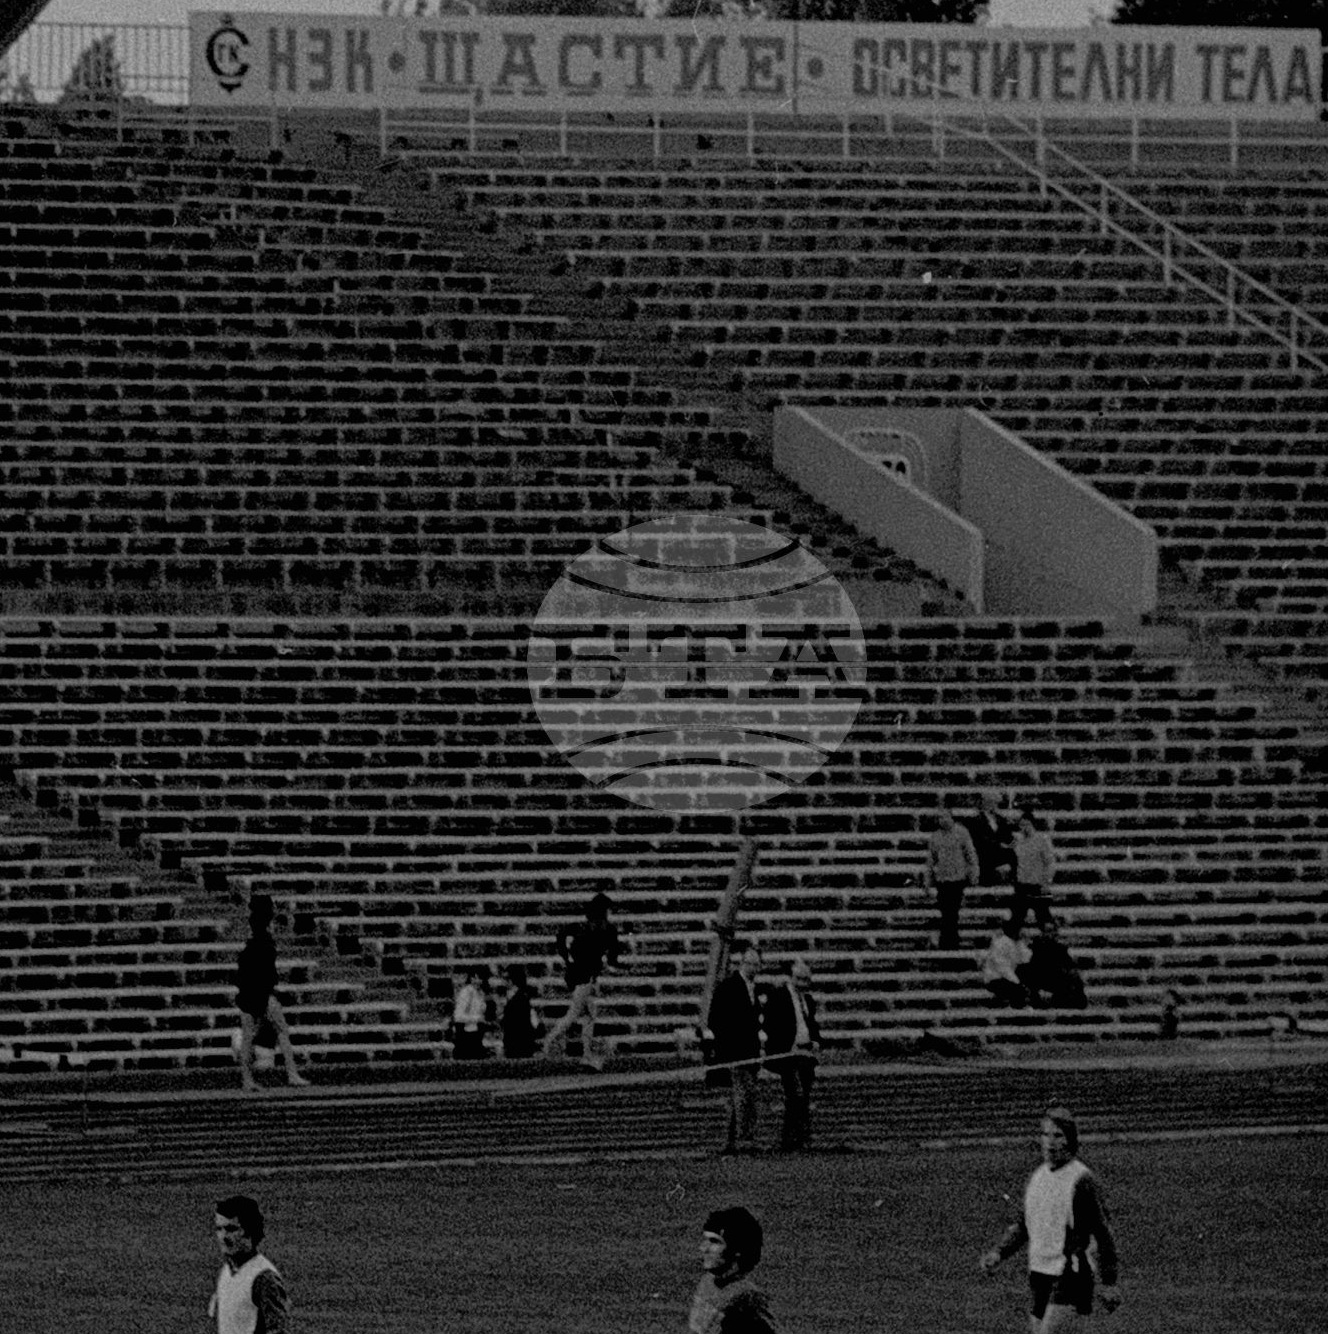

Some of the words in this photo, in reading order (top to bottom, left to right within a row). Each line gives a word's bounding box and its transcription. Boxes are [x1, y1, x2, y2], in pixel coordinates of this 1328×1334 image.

[418, 31, 785, 105] ЩАСТИЕ
[852, 36, 1175, 103] ОСВЕТИТЕЛНИ
[1196, 43, 1314, 104] ТЕЛА
